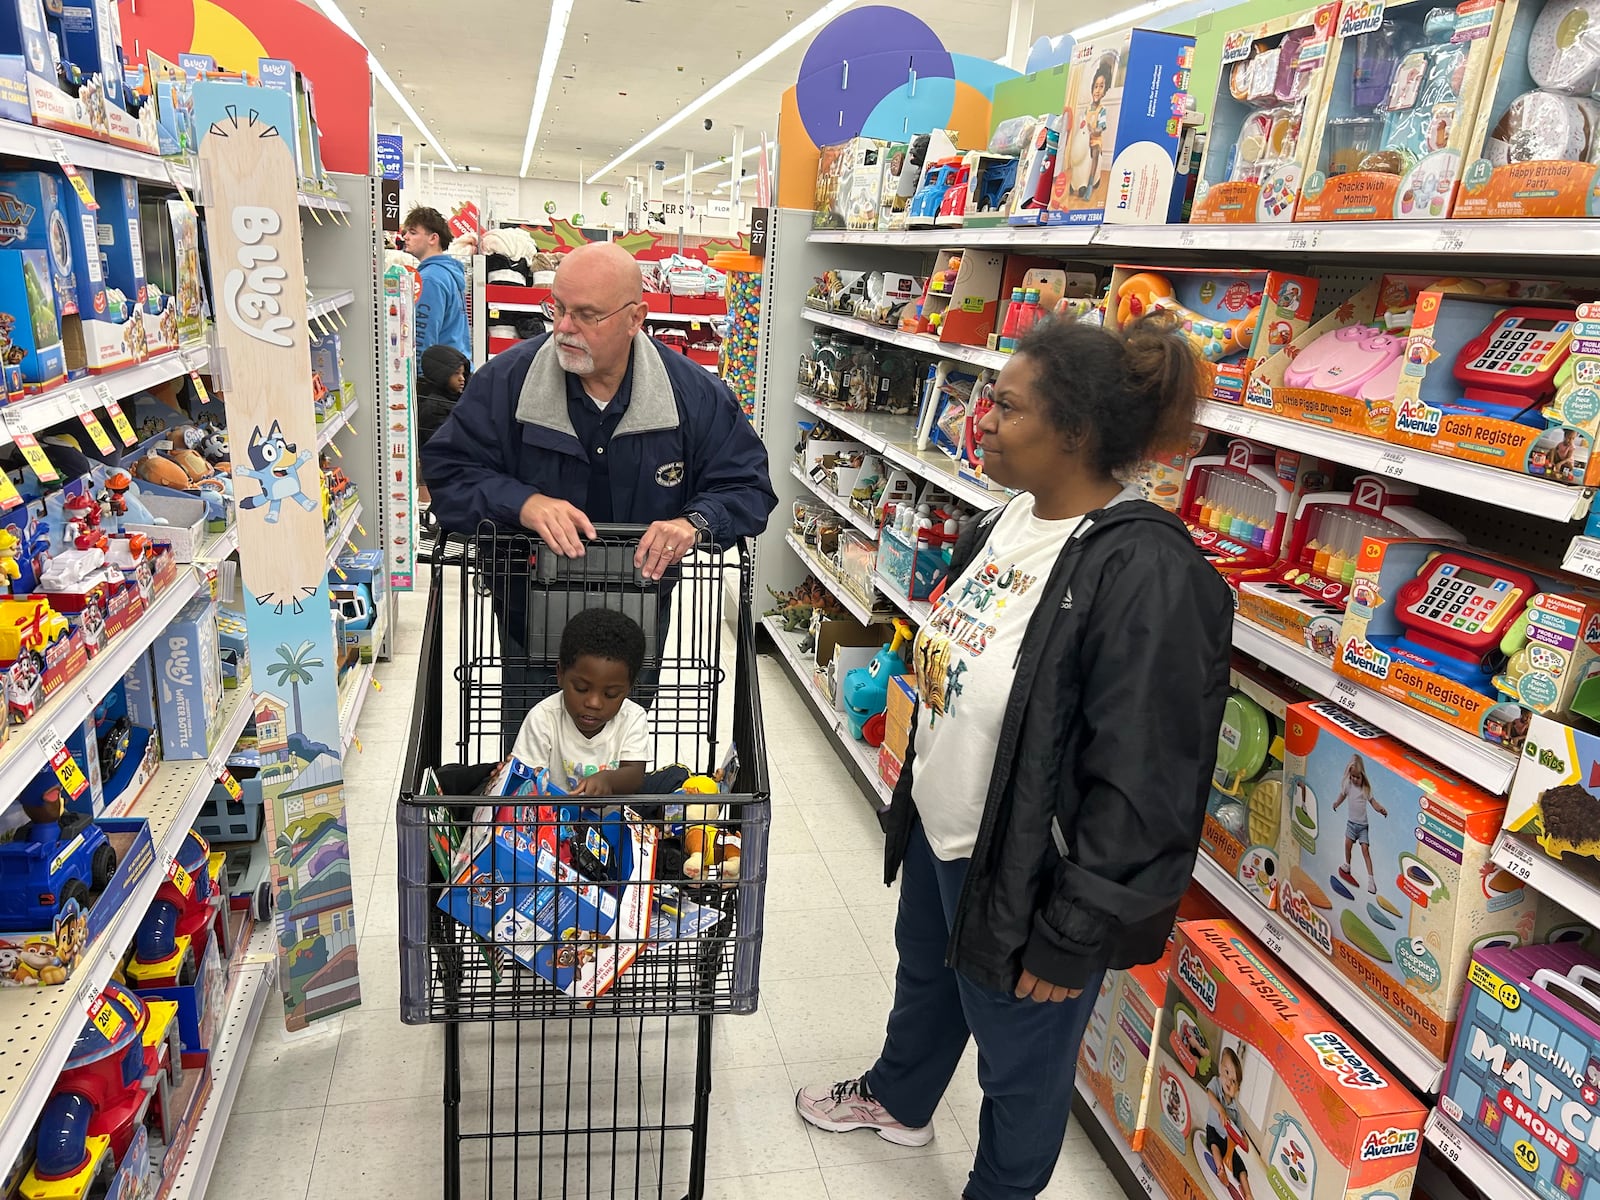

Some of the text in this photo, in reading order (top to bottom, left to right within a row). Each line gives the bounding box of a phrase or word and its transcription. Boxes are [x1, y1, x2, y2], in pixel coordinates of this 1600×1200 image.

[1345, 4, 1383, 22] Acorn
[1341, 15, 1380, 34] Avenue
[1225, 35, 1251, 49] Acorn
[1224, 47, 1249, 60] Avenue
[386, 163, 400, 171] off
[1474, 163, 1485, 178] 19
[1510, 165, 1572, 180] Happy Birthday
[1117, 169, 1132, 209] battat
[1337, 181, 1384, 192] Snacks With
[1526, 178, 1548, 189] Party
[388, 193, 396, 204] C
[1343, 194, 1373, 207] Mommy
[386, 207, 398, 218] 27
[1088, 212, 1102, 222] ZEBRA
[754, 220, 763, 230] C
[752, 233, 763, 244] 27
[1292, 239, 1307, 249] 17.99
[1442, 241, 1464, 250] 17.99
[1424, 299, 1434, 310] 3+
[1247, 393, 1272, 407] Avenue
[1282, 394, 1352, 416] Little Piggie Drum Set
[1369, 406, 1390, 418] TRY ME!
[1399, 400, 1440, 422] Acorn
[1398, 414, 1438, 434] Avenue
[1445, 420, 1527, 447] Cash Register
[1384, 465, 1403, 476] 16.99
[1367, 546, 1379, 556] 3+
[1582, 564, 1600, 577] 16.9
[1355, 578, 1380, 592] TRY ME!
[1545, 603, 1559, 611] PLAY
[1547, 598, 1583, 614] IMAGINATIVE
[1540, 618, 1566, 631] THINKING
[1542, 613, 1566, 625] CRITICAL
[1536, 633, 1559, 645] SOLVING
[1537, 628, 1563, 641] PROBLEM
[165, 636, 193, 686] BLUEY
[1346, 639, 1388, 667] Acorn
[1345, 650, 1387, 677] Avenue
[1395, 668, 1480, 712] Cash Register
[175, 688, 187, 716] WATER
[1338, 696, 1356, 710] 16.99
[1314, 703, 1376, 738] Avenue
[178, 717, 190, 749] BOTTLE
[54, 751, 68, 766] sale
[1540, 749, 1565, 773] KIDS
[1206, 823, 1239, 861] Waffles
[169, 863, 178, 876] sale
[1507, 861, 1531, 879] 17.99
[1282, 884, 1329, 934] Acorn
[1283, 898, 1331, 951] Avenue
[1267, 938, 1283, 954] 27.99
[1411, 936, 1426, 956] 6
[1400, 947, 1437, 978] Stepping
[1181, 947, 1216, 996] Acorn
[1402, 958, 1434, 984] Stones!
[1473, 964, 1493, 980] GROW-
[1179, 961, 1214, 1008] Avenue
[1473, 970, 1496, 990] WITH-ME
[1339, 945, 1390, 1000] Stepping
[1393, 992, 1438, 1037] Stones
[90, 998, 104, 1015] sale
[1308, 1036, 1372, 1087] Acorn
[1324, 1033, 1383, 1085] Avenue
[1510, 1031, 1585, 1089] MATCHING
[1503, 1096, 1571, 1158] & MORE
[1364, 1131, 1418, 1149] Acorn
[1363, 1142, 1416, 1158] Avenue
[1437, 1140, 1460, 1162] 15.99
[1516, 1143, 1537, 1164] 40
